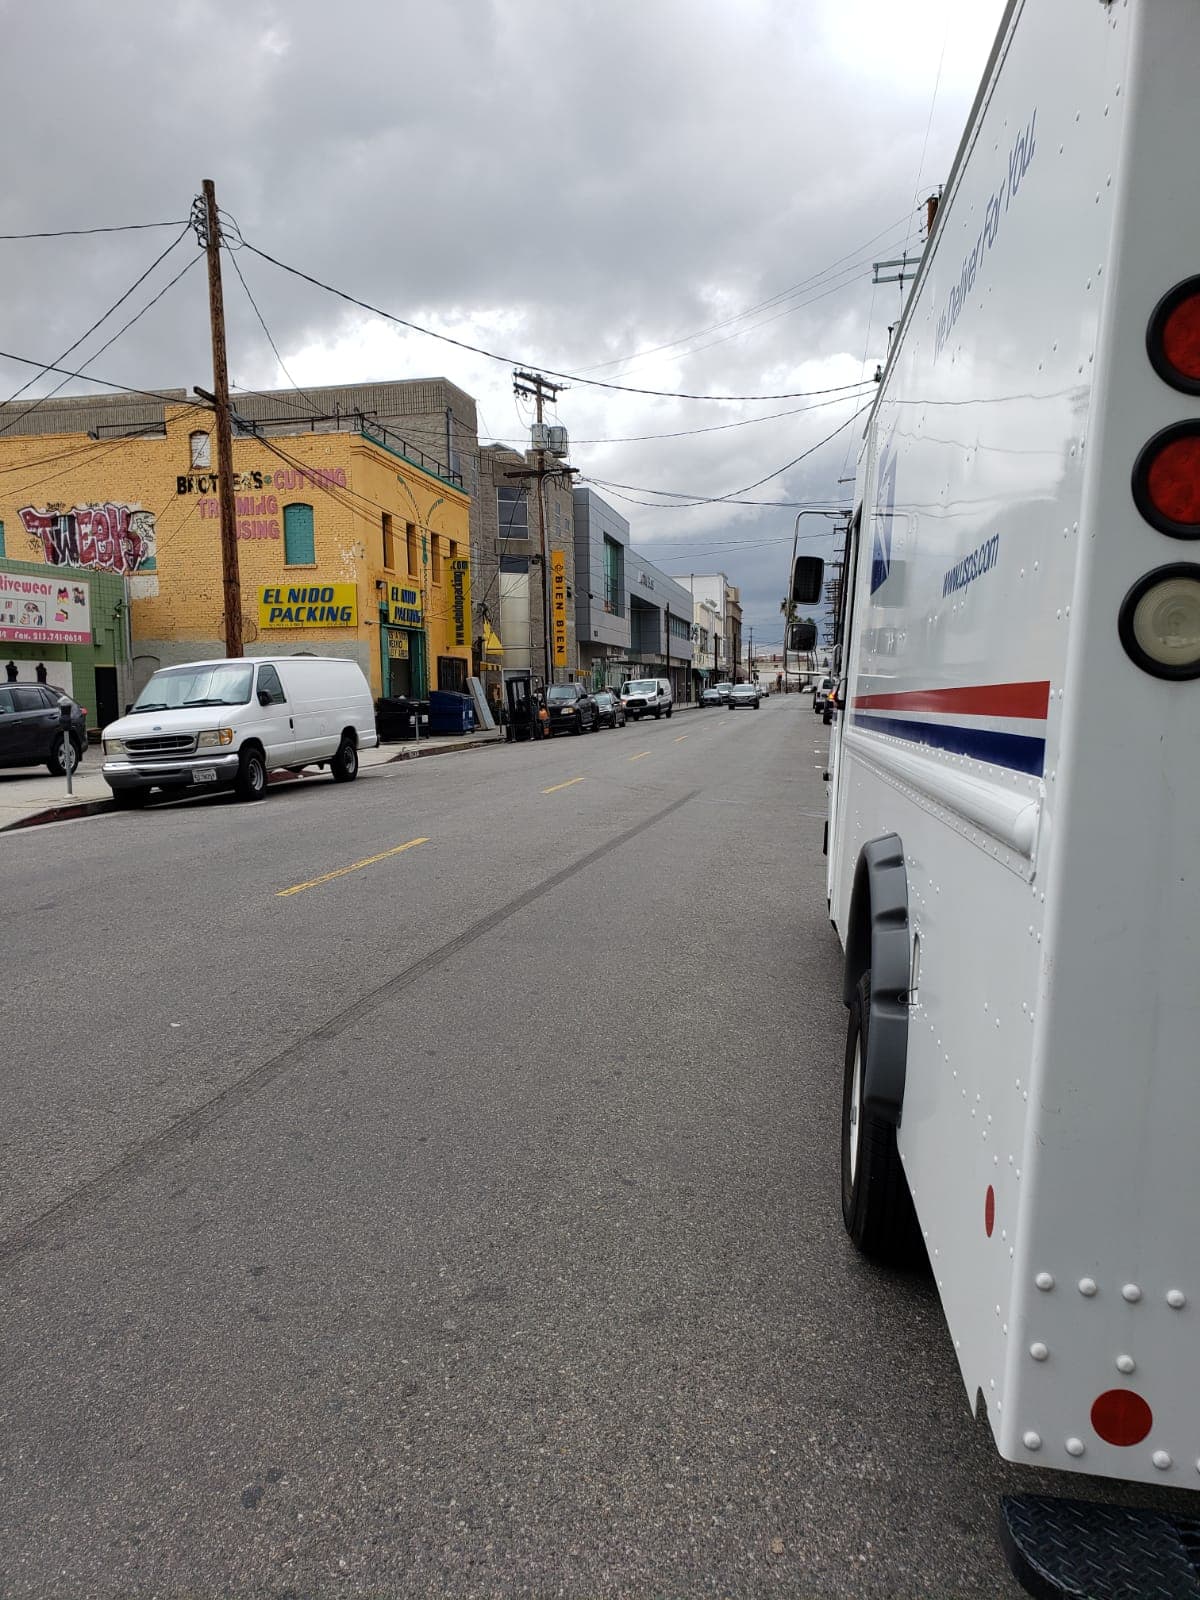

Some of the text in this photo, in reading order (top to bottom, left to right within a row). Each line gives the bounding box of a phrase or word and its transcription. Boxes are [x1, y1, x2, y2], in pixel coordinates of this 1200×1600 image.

[946, 231, 982, 341] Deliver
[980, 177, 1006, 269] For
[177, 467, 347, 495] BROTER'S CUTTING
[943, 533, 999, 598] www.usps.com
[263, 587, 334, 604] EL NIDO
[269, 606, 353, 623] PACKING
[555, 576, 565, 654] BIEN BIEN
